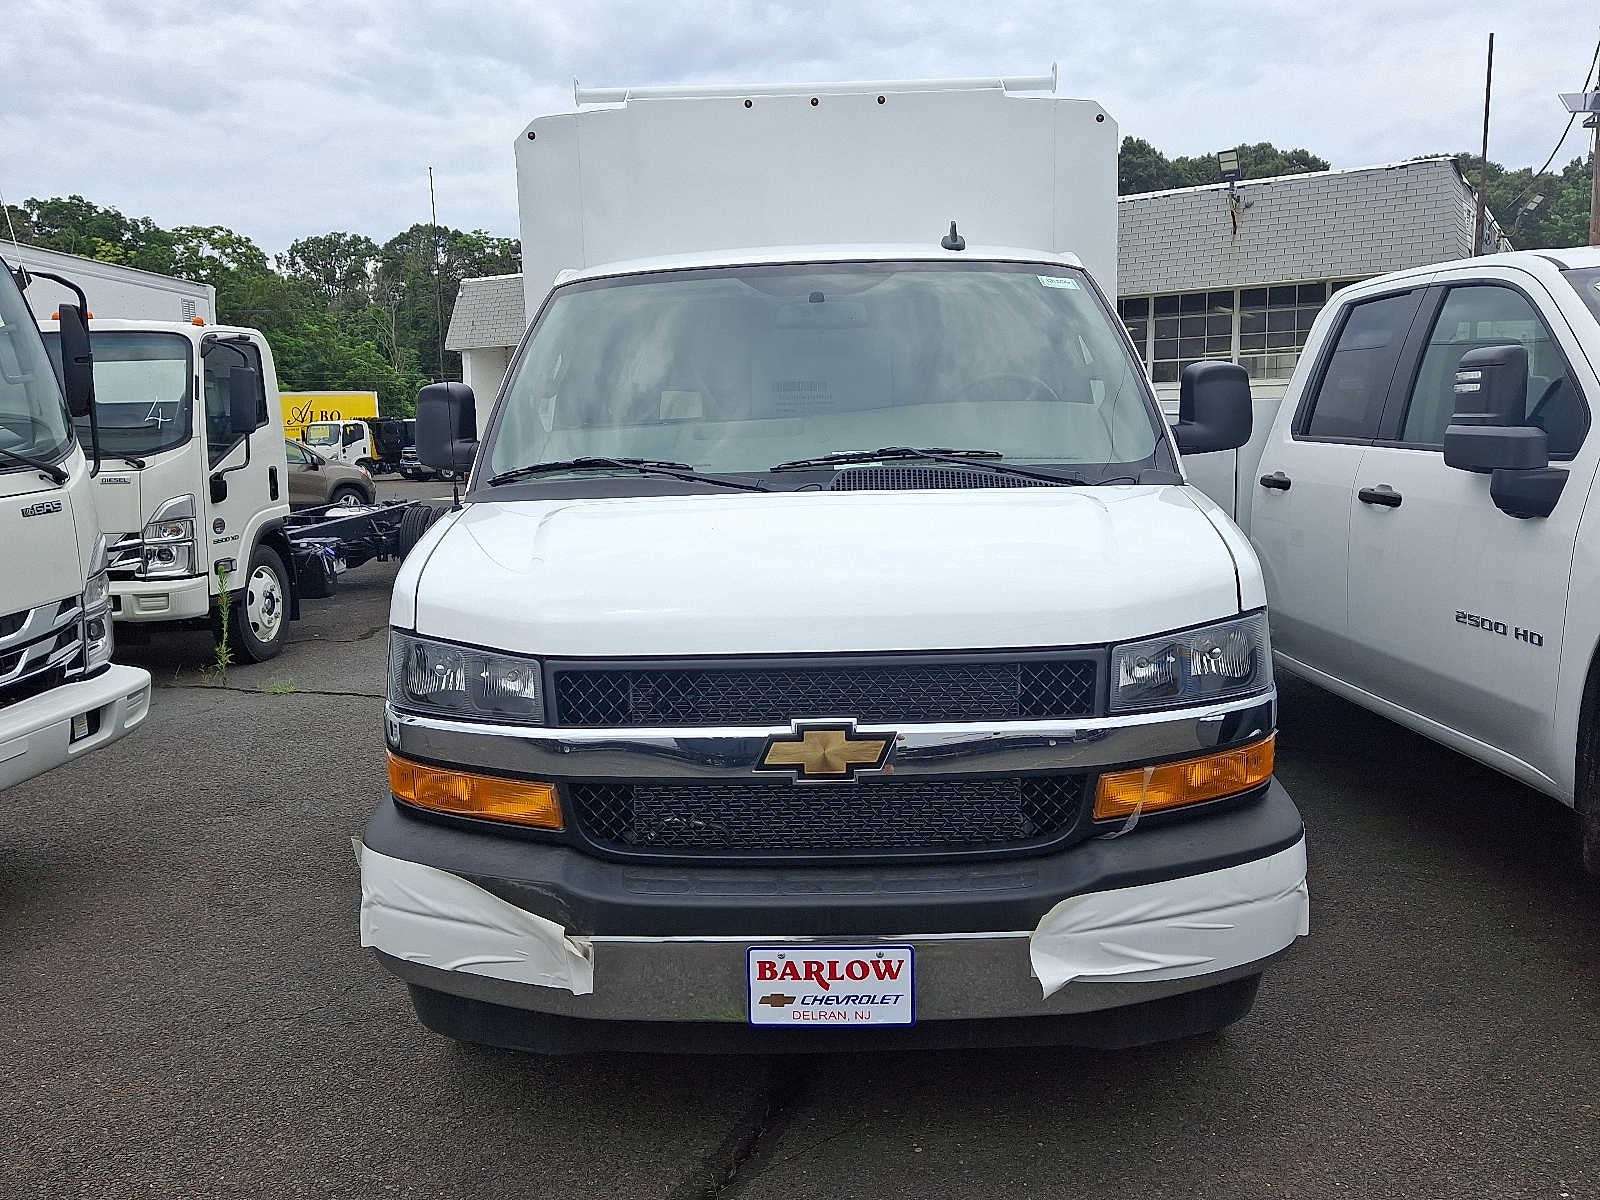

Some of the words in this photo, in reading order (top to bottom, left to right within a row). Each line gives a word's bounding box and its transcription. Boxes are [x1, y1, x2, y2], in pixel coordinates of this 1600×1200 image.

[144, 395, 173, 430] 4
[101, 476, 130, 484] DIESEL
[1455, 608, 1507, 636] 2500
[1514, 626, 1544, 647] HD
[757, 959, 905, 991] BARLOW
[800, 994, 904, 1006] CHEVROLET
[792, 1010, 850, 1022] DELRAN,
[854, 1010, 871, 1021] NJ
